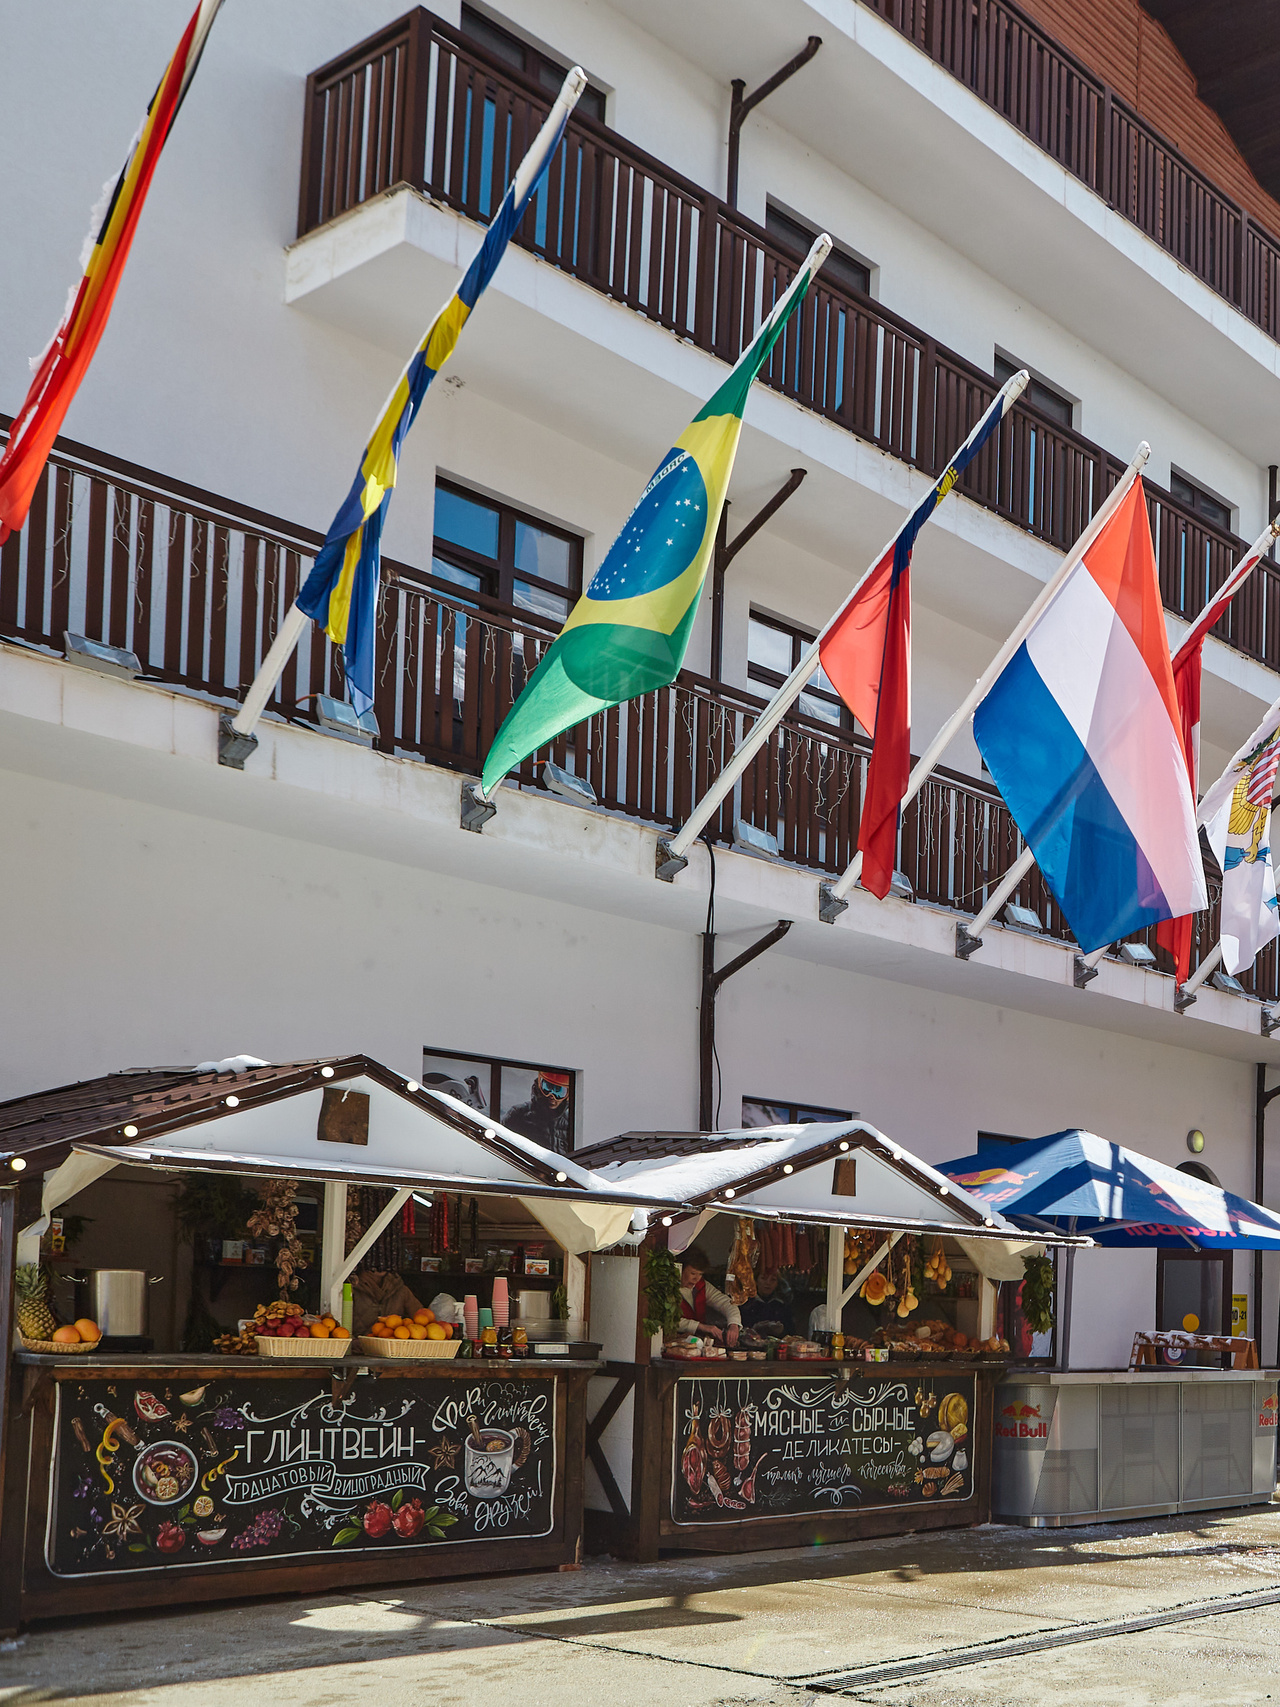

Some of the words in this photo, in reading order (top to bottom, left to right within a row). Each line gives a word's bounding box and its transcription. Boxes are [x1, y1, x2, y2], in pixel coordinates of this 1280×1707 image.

[432, 1387, 486, 1433] Бери
[754, 1409, 826, 1437] МЯСНЫЕ
[852, 1406, 917, 1433] СЫРНЫЕ
[1259, 1413, 1274, 1426] Red
[995, 1421, 1017, 1438] Red
[1019, 1422, 1047, 1438] Bull
[233, 1465, 333, 1500] ГРАНАТОВЫЙ
[334, 1466, 421, 1496] ВИНОГРАДНЫЙ
[762, 1465, 803, 1486] только
[807, 1461, 852, 1486] лучшего
[858, 1451, 912, 1481] качества
[434, 1475, 468, 1516] Зови
